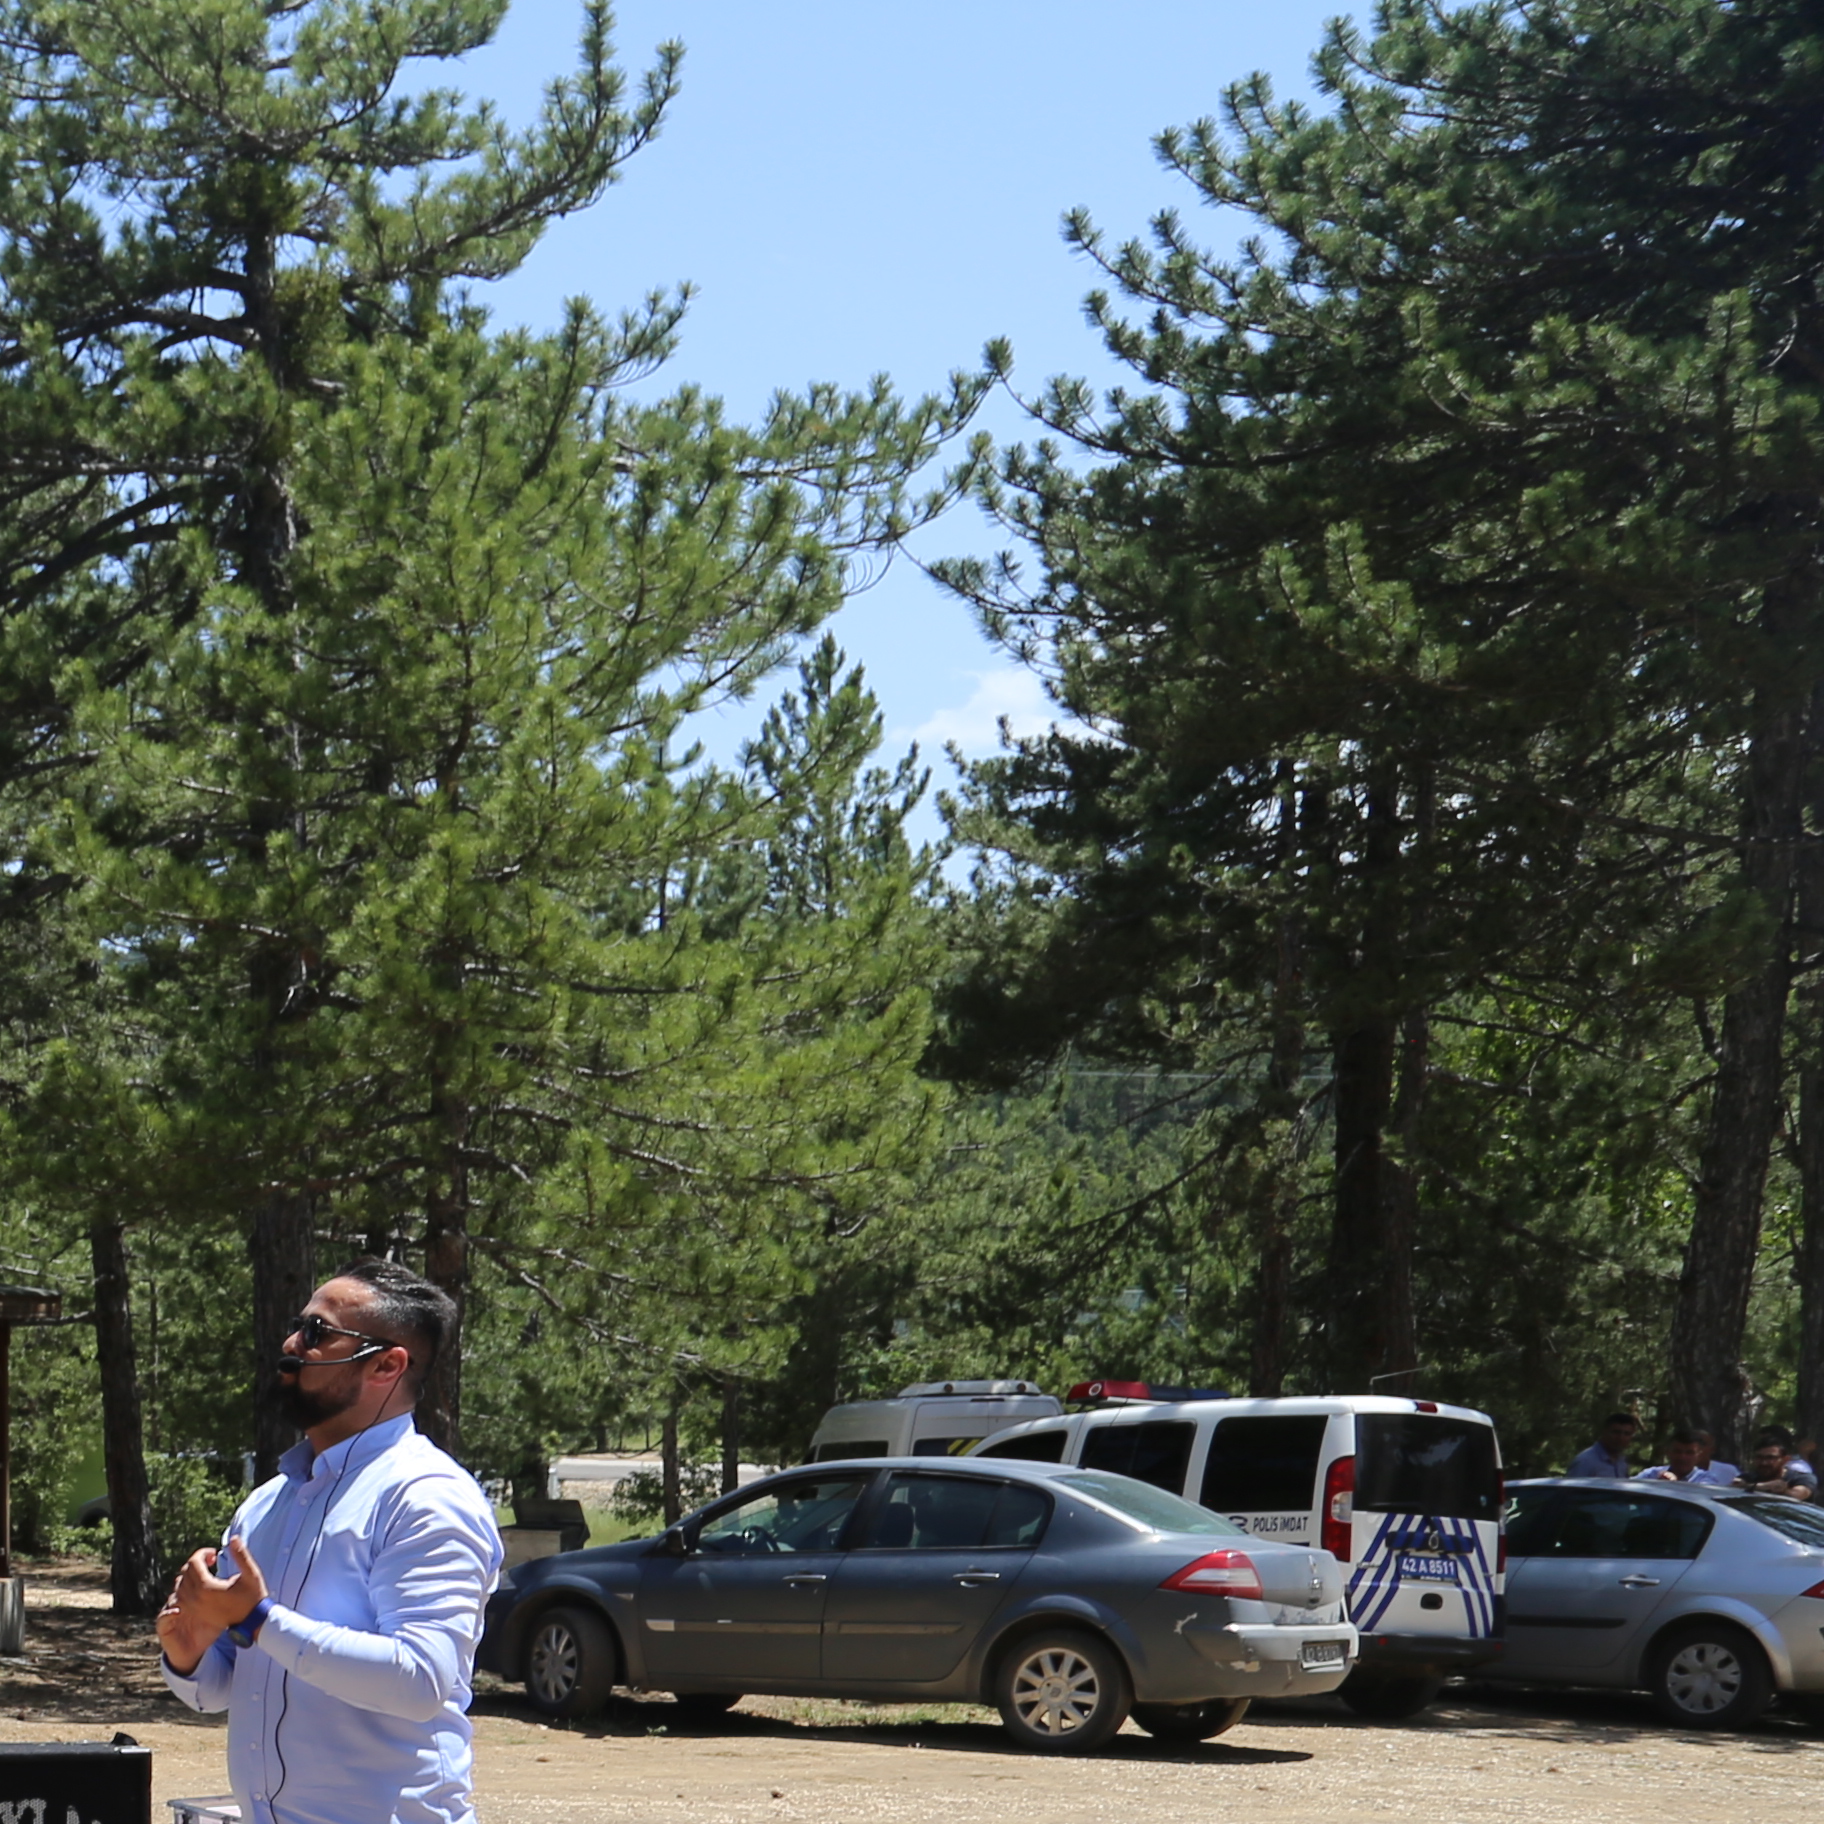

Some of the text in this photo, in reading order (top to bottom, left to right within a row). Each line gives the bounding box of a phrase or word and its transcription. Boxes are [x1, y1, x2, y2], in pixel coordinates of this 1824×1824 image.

[1402, 1557, 1455, 1575] 42 A 8511
